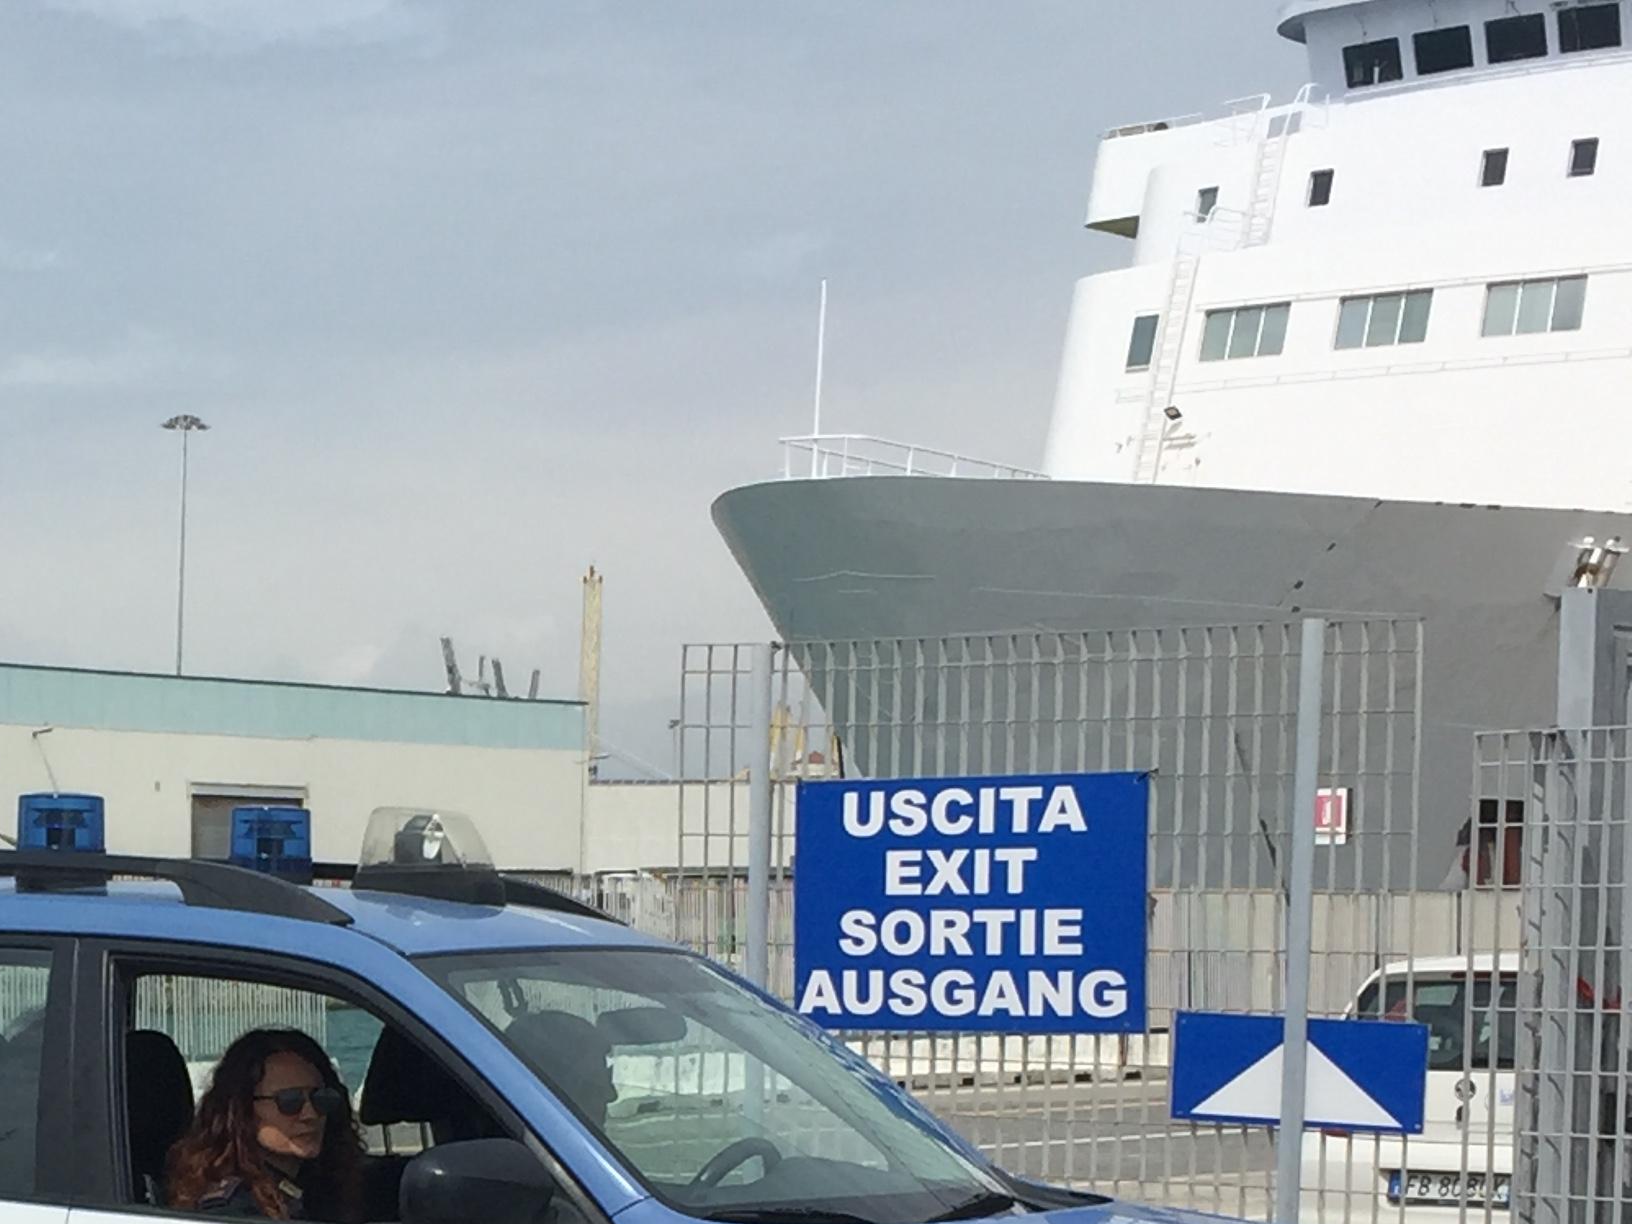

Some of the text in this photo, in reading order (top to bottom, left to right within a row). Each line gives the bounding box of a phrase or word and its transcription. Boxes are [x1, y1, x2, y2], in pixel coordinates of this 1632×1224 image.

[842, 785, 1088, 837] USCITA
[884, 848, 1038, 896] EXIT
[838, 908, 1084, 957] SORTIE
[798, 969, 1128, 1018] AUSGANG
